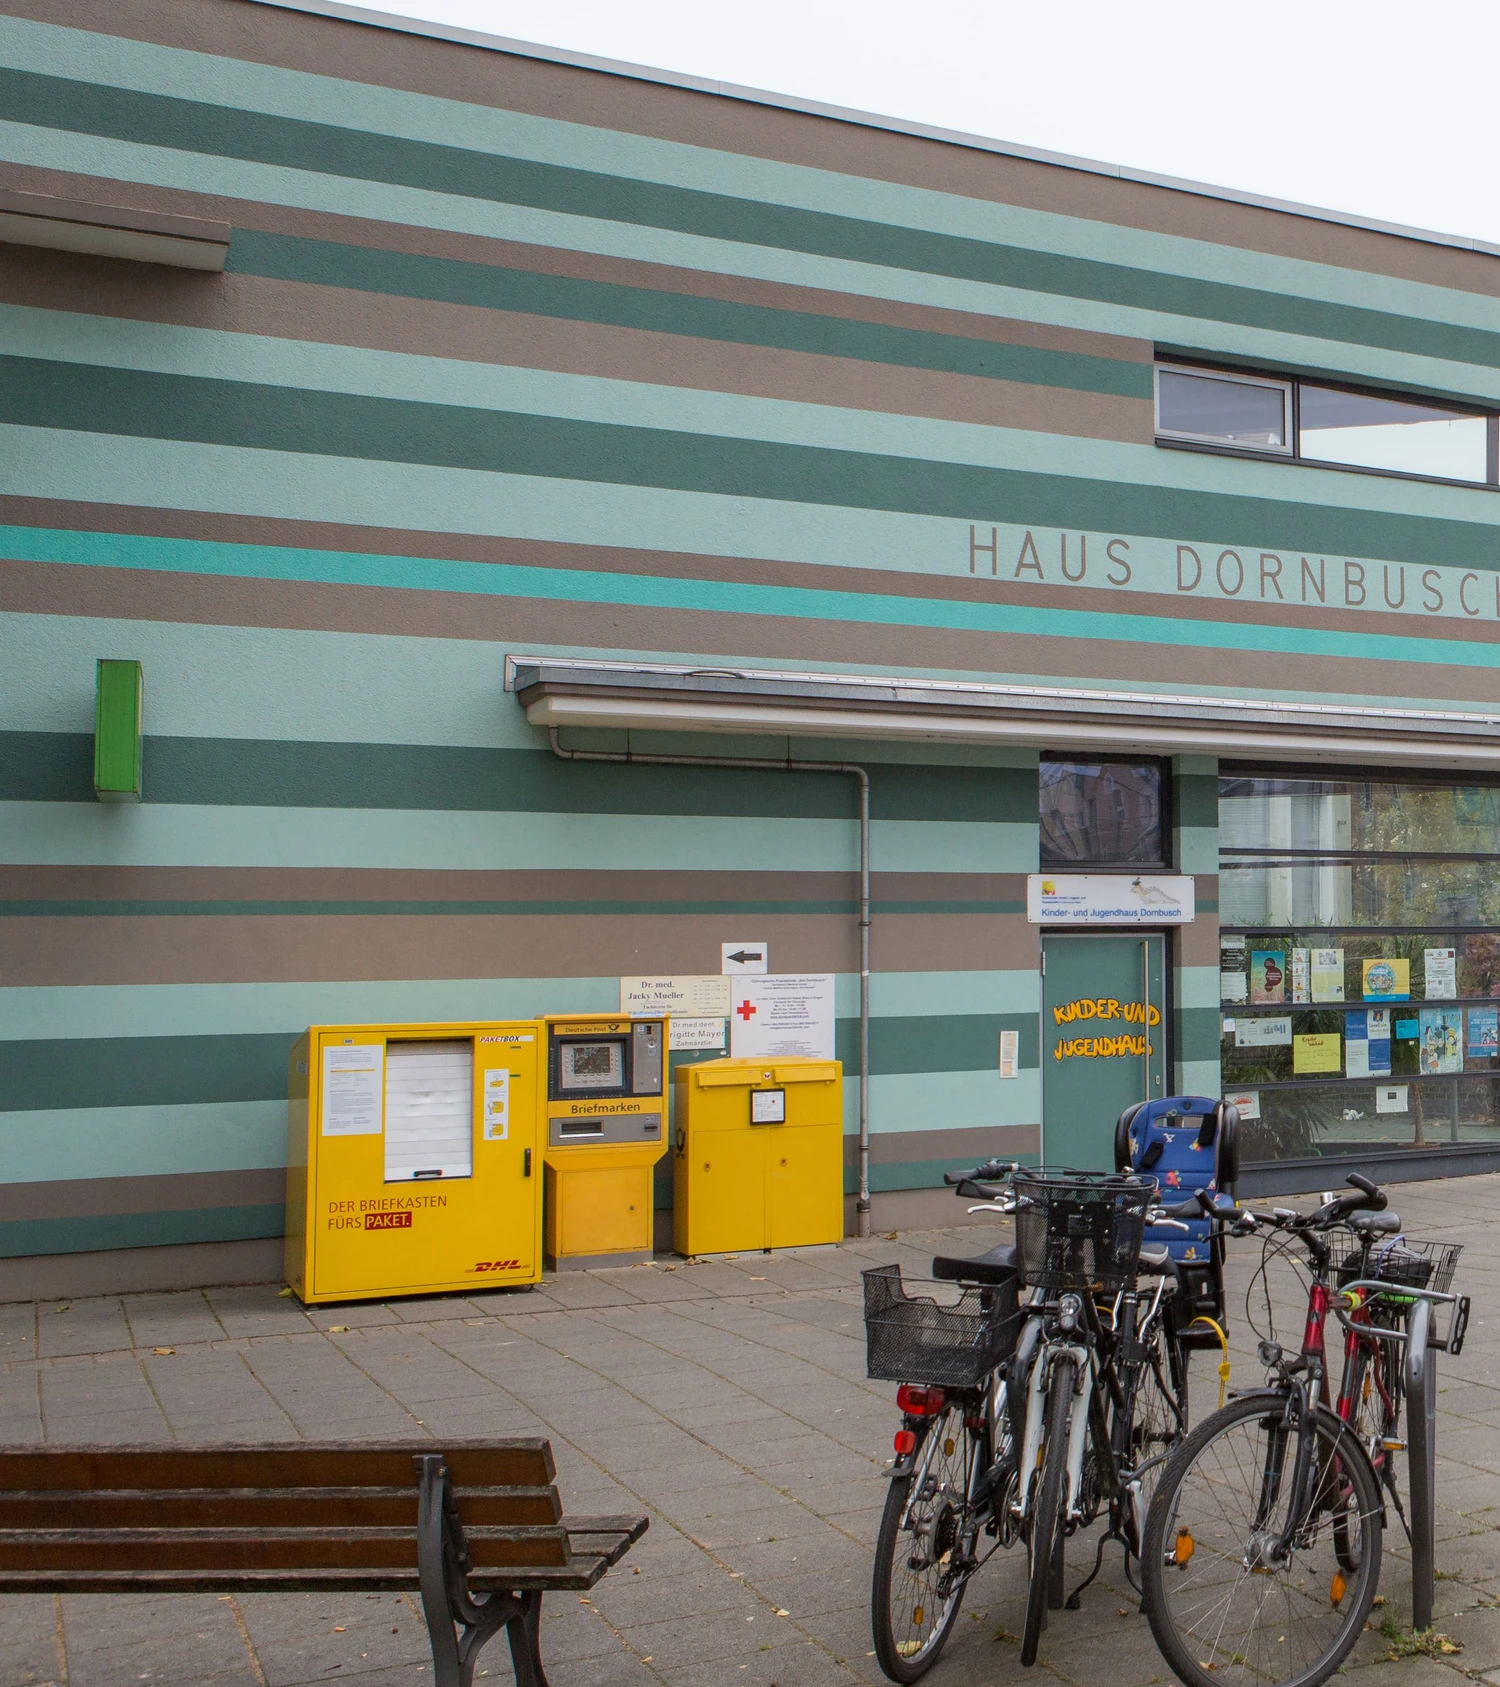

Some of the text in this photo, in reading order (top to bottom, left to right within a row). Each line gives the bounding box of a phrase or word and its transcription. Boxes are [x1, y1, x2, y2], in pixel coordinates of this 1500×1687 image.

[968, 524, 1132, 586] HAUS
[1041, 908, 1182, 918] Kinder- und Jugendhaus Dornbusch
[628, 991, 684, 1001] Jacky Mueller
[669, 1031, 696, 1039] rigitte
[1053, 1034, 1153, 1061] JUGENDHAUS
[571, 1102, 640, 1114] Briefmarken
[329, 1196, 447, 1213] DER BRIEFKASTEN
[328, 1214, 410, 1230] FÜRS PAKET.
[474, 1260, 521, 1272] DHL
